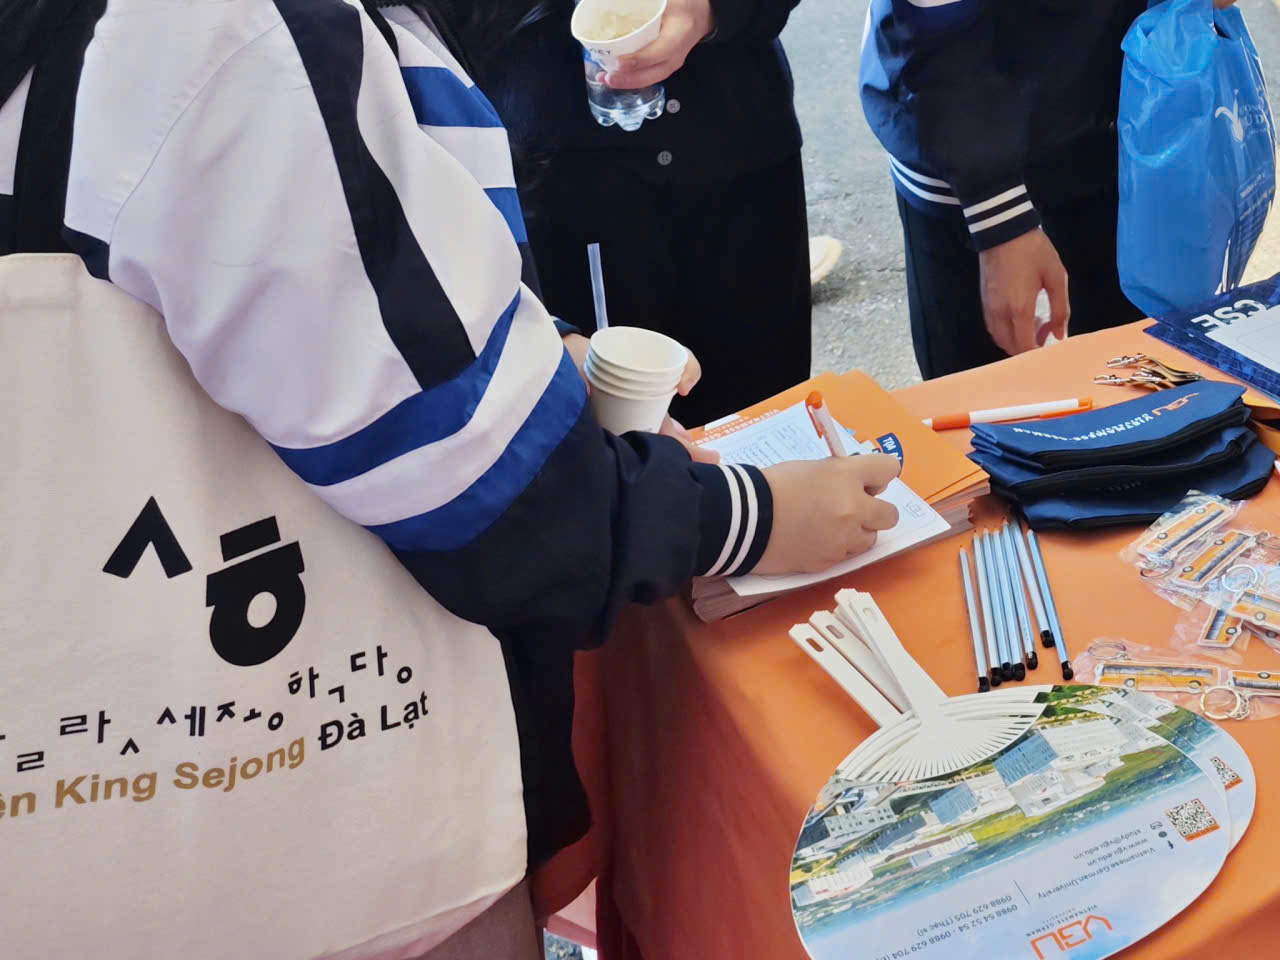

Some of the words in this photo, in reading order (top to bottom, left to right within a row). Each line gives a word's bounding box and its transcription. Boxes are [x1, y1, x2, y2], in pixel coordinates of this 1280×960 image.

[1191, 299, 1268, 331] CSE
[54, 771, 158, 808] King
[173, 736, 306, 793] Sejong
[318, 712, 366, 751] Đà
[380, 691, 430, 732] Lạt
